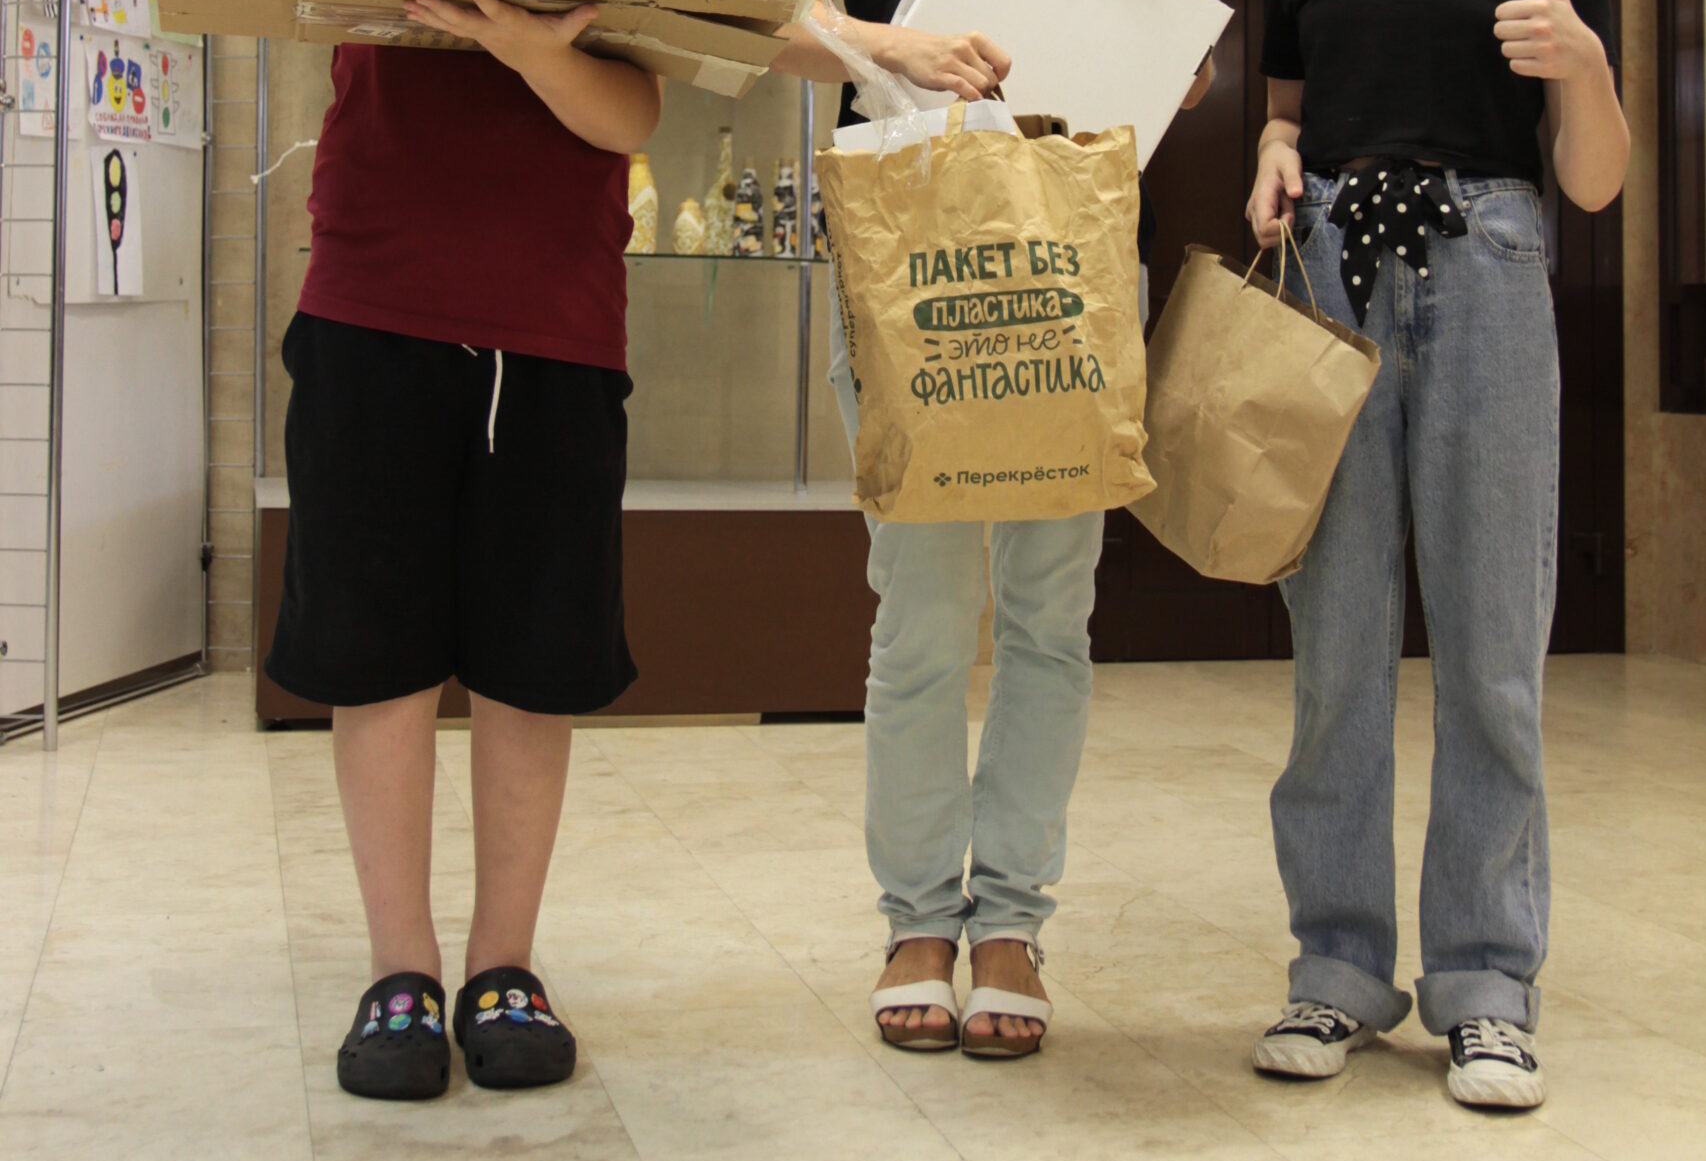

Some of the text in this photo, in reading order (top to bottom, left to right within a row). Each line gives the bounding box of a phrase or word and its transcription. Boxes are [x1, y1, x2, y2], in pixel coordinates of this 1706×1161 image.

[909, 241, 1080, 287] ПАКЕТ БЕЗ
[948, 328, 1060, 360] это не
[957, 464, 1090, 487] Перекрёсток
